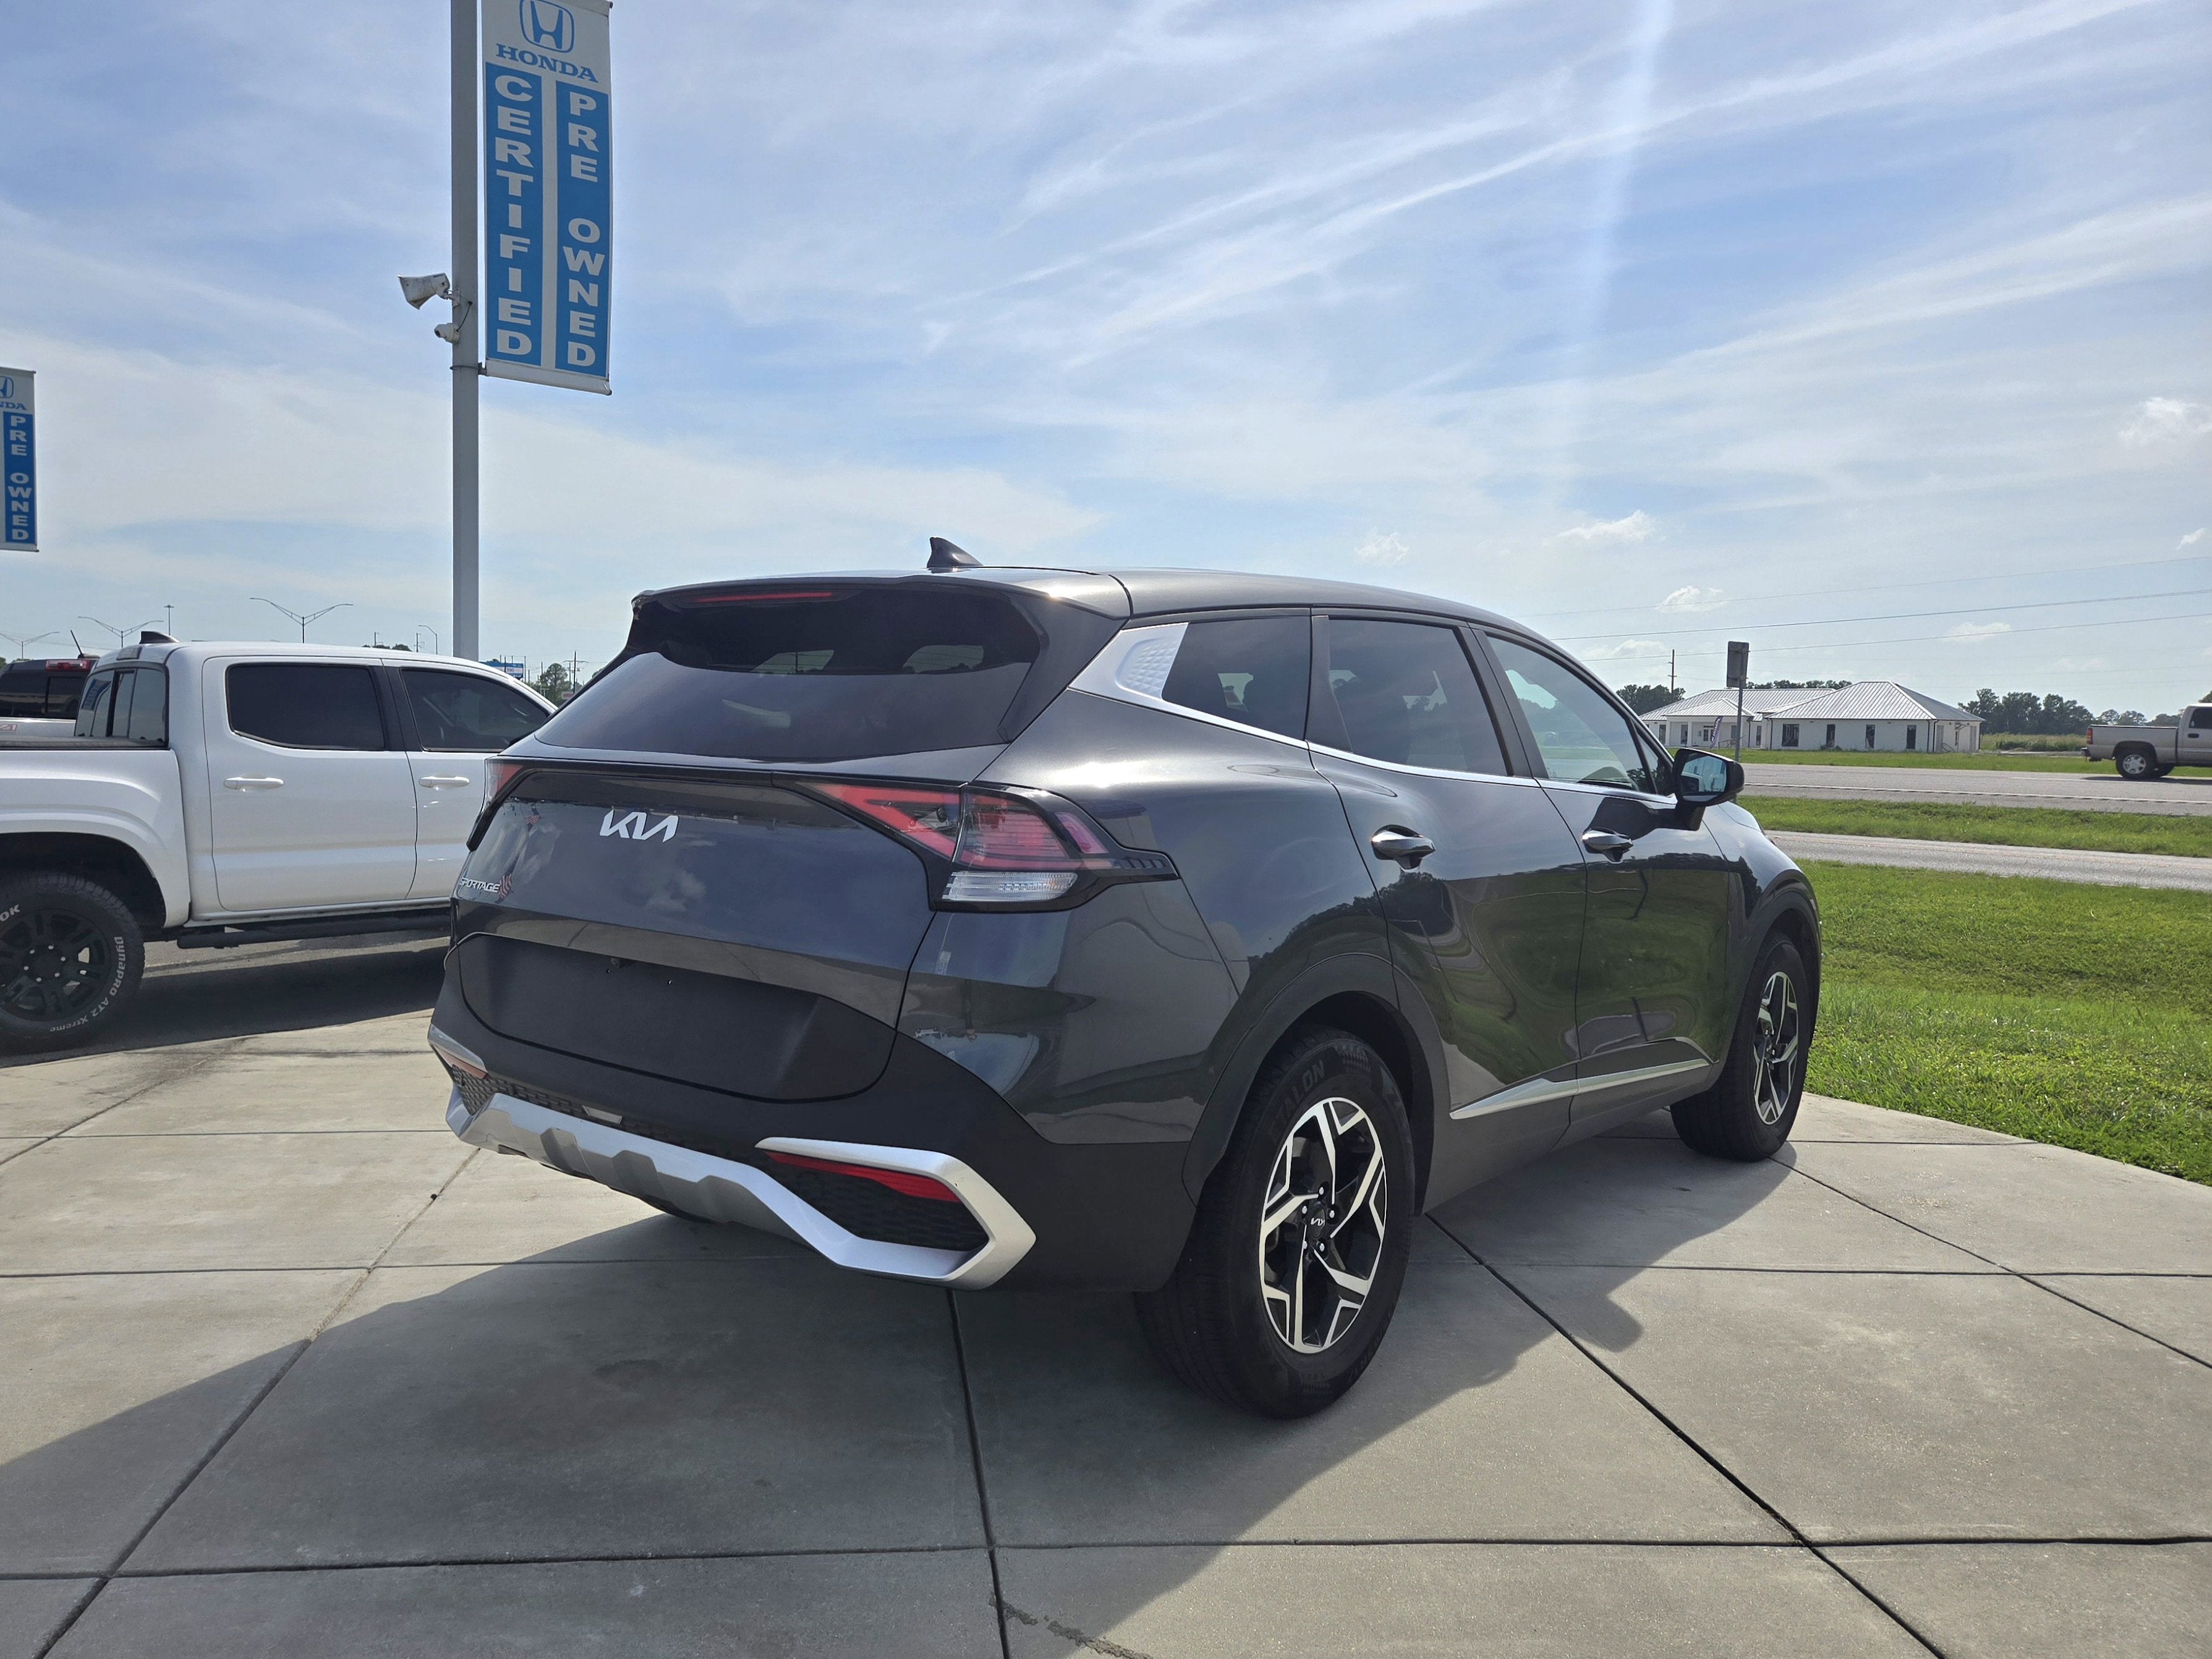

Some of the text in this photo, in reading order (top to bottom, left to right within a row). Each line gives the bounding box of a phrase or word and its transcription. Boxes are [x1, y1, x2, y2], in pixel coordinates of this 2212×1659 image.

[496, 43, 598, 83] HONDA
[495, 75, 534, 355] CERTIFIED
[563, 91, 605, 367] PRE OWNED
[0, 401, 28, 410] DA
[7, 415, 32, 541] PRE OWNED
[600, 810, 679, 842] KIA
[459, 877, 501, 893] SPORTAGE
